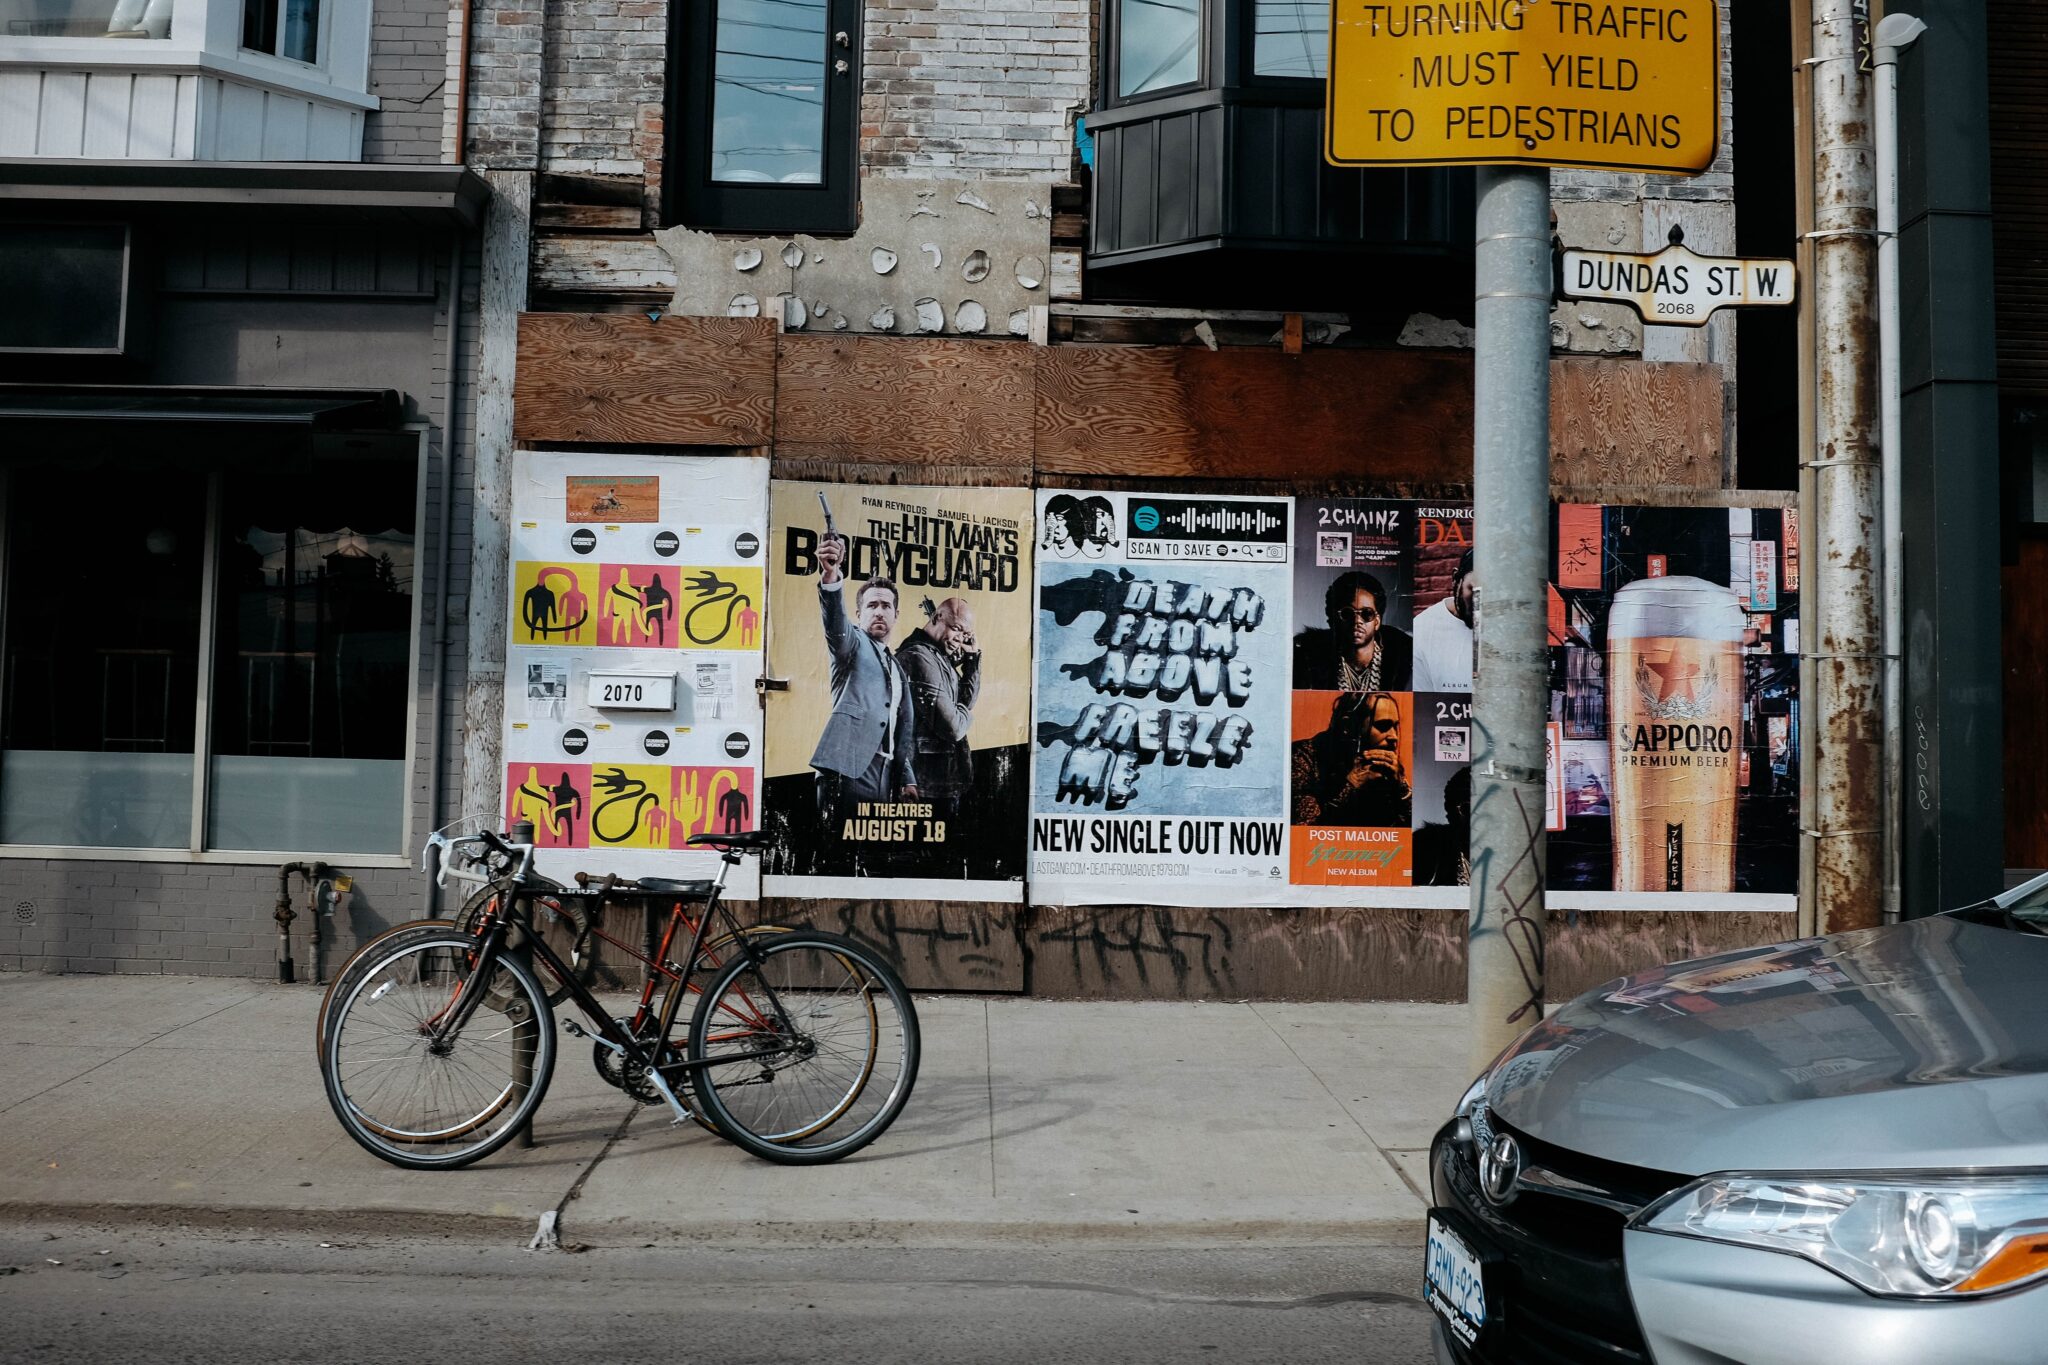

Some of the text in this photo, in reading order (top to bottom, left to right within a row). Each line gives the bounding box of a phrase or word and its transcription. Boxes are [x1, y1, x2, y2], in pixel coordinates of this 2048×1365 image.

[1365, 0, 1688, 43] TURNING TRAFFIC
[1412, 52, 1638, 91] MUST YIELD
[1369, 105, 1681, 149] TO PEDESTRIANS
[1579, 261, 1782, 299] DUNDAS ST. W.
[1657, 301, 1695, 316] 2068
[862, 496, 883, 508] RYAN
[885, 501, 927, 516] REYNOLDS
[937, 509, 971, 522] SAMUEL
[982, 516, 1019, 529] JACKSON
[867, 513, 1019, 556] THE HITMAN'S
[1418, 518, 1474, 547] DA
[1131, 542, 1211, 556] SCAN TO SAVE
[1325, 557, 1344, 565] TRAP
[1122, 580, 1265, 627] DEATH
[1110, 613, 1237, 655] FROM
[1097, 649, 1252, 704] ABOVE
[603, 684, 643, 702] 2070
[1074, 702, 1251, 763] FREEZE
[1619, 724, 1732, 753] SAPPORO
[1443, 752, 1462, 760] TRAP
[1621, 755, 1729, 768] PREMIUM BEER
[1059, 743, 1140, 804] ME
[857, 803, 933, 818] IN THEATRES
[842, 819, 946, 843] AUGUST 18
[1033, 818, 1284, 856] NEW SINGLE OUT NOW
[1309, 829, 1399, 842] POST MALONE
[1327, 868, 1378, 877] NEW ALBUM
